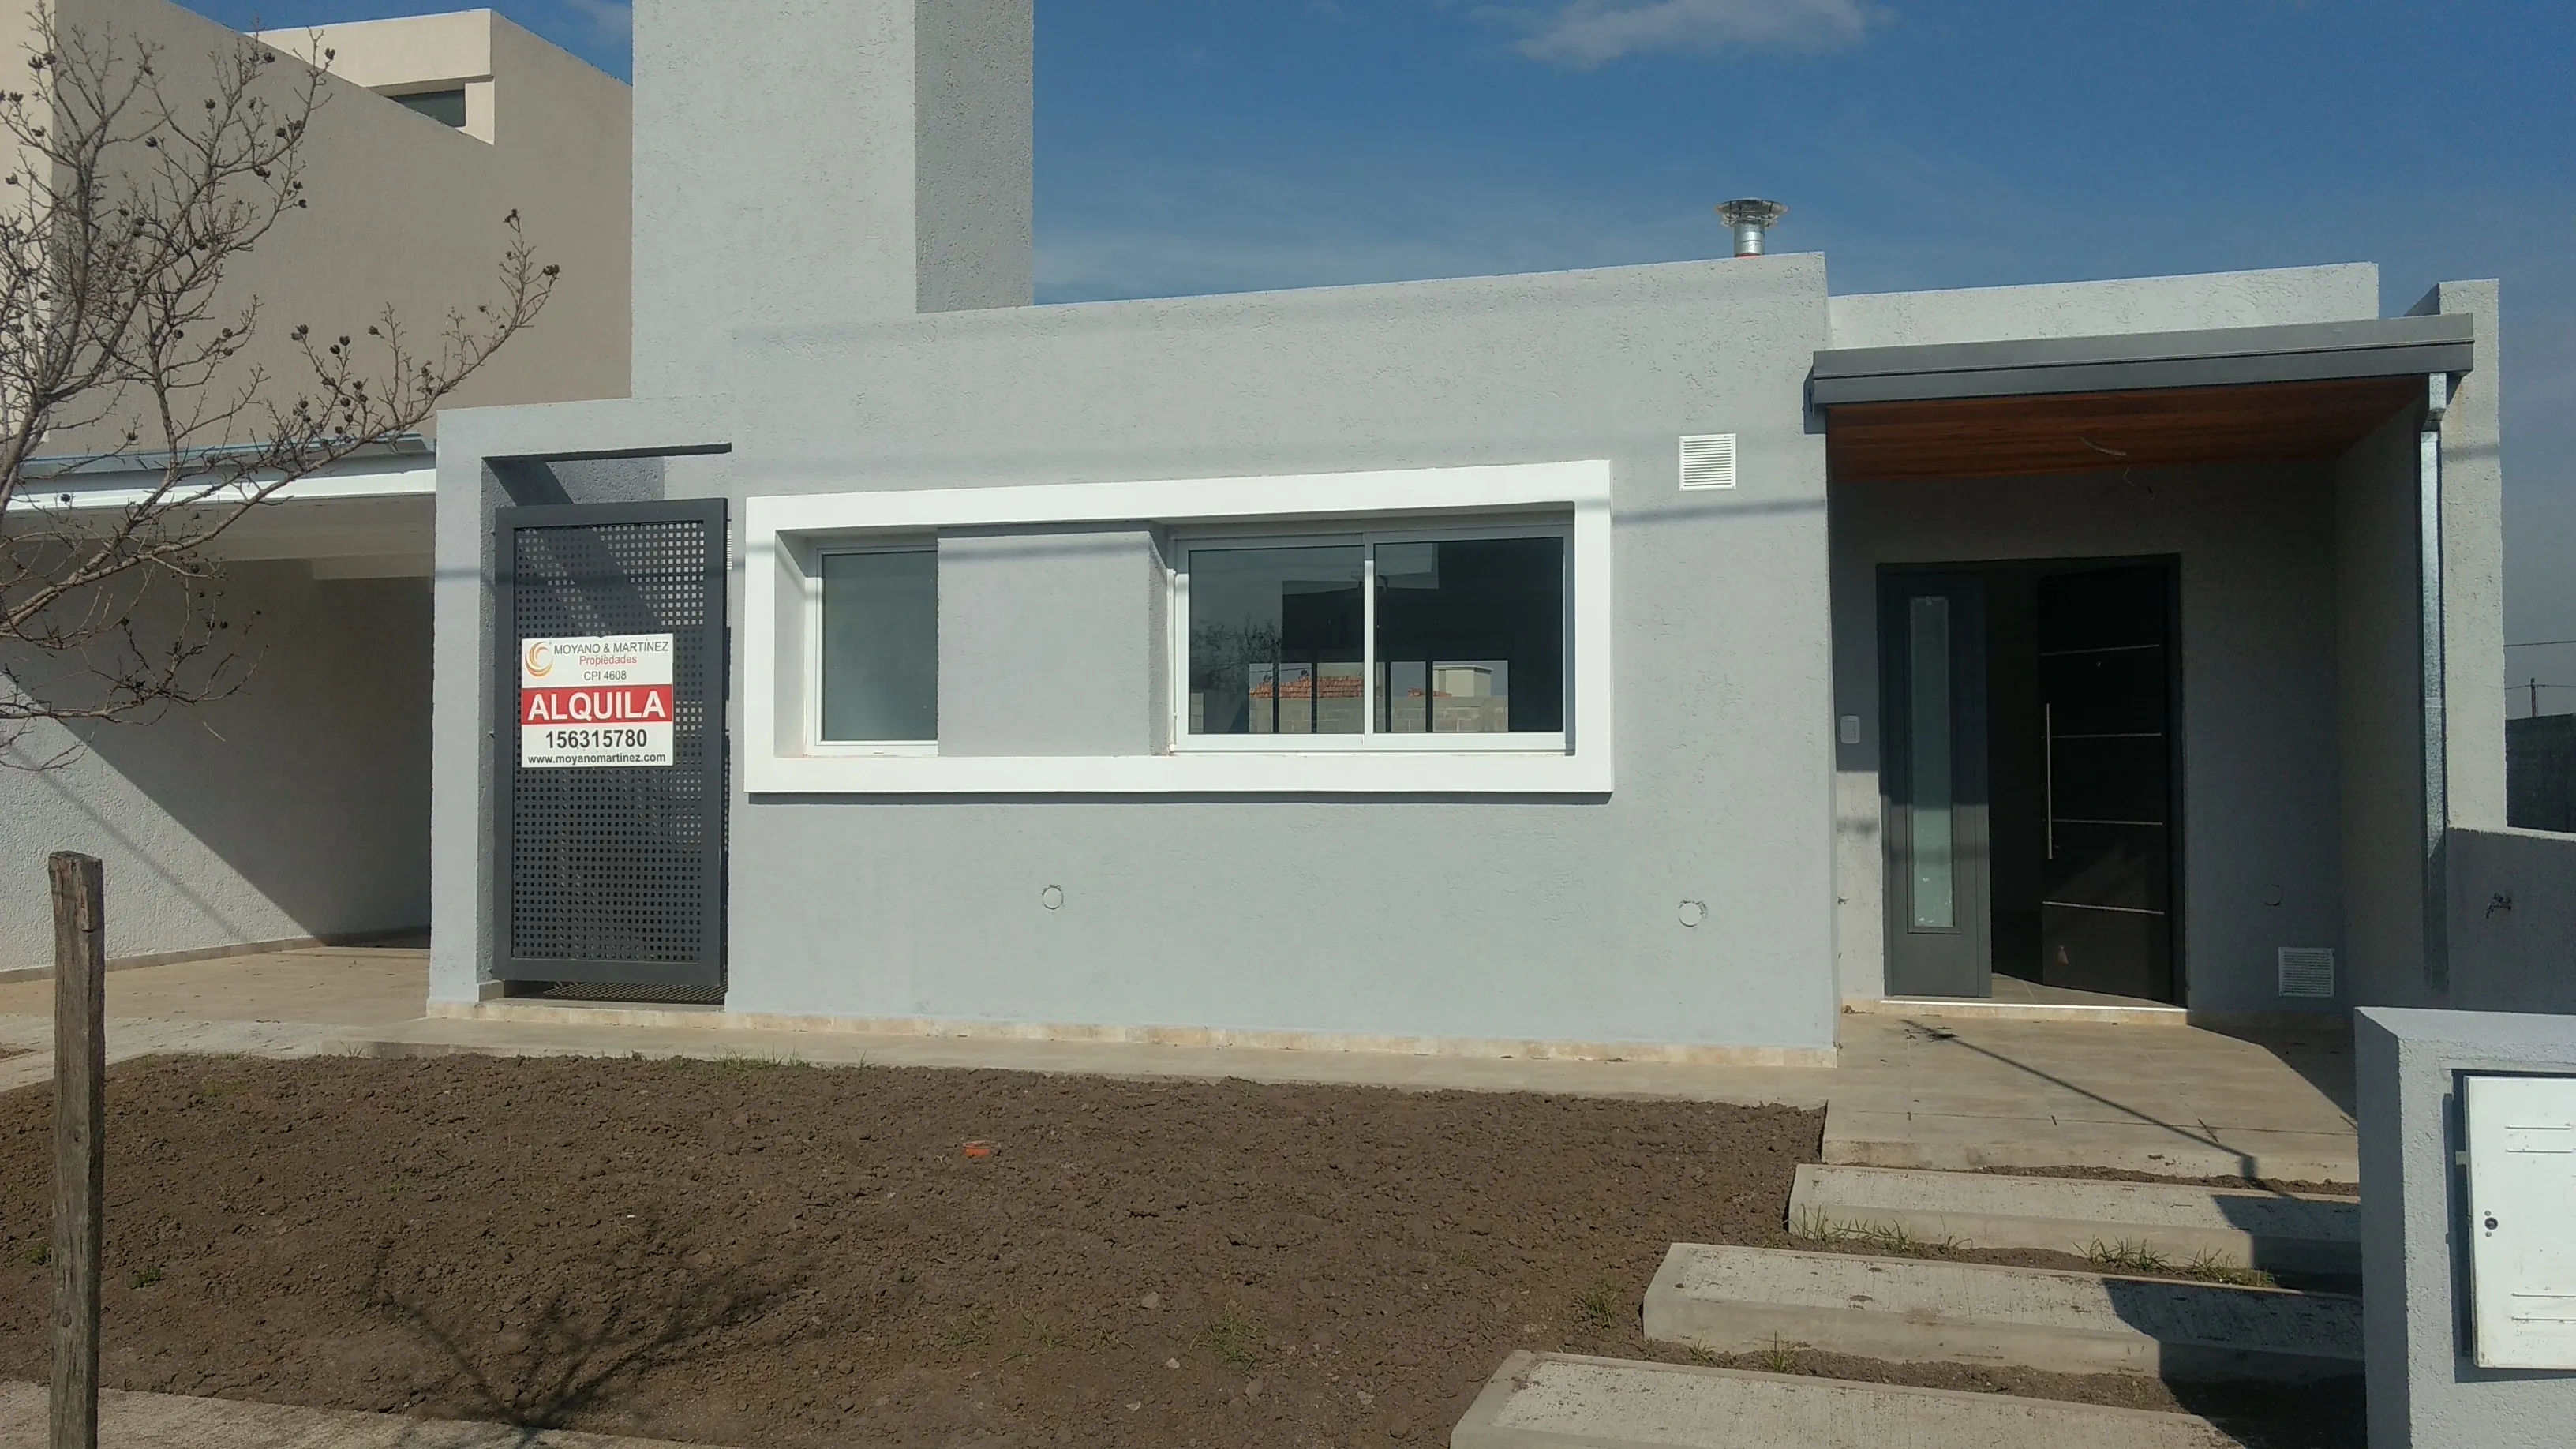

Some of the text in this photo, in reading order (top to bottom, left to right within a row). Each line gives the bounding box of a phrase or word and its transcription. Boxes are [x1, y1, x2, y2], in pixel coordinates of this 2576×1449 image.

[553, 642, 669, 654] MOYANO & MARTINEZ
[579, 654, 638, 666] Propiedades
[583, 670, 627, 680] CPI 4608
[527, 691, 666, 721] ALQUILA
[545, 728, 648, 749] 156315780
[527, 752, 666, 766] www.moyanomartinez.com
